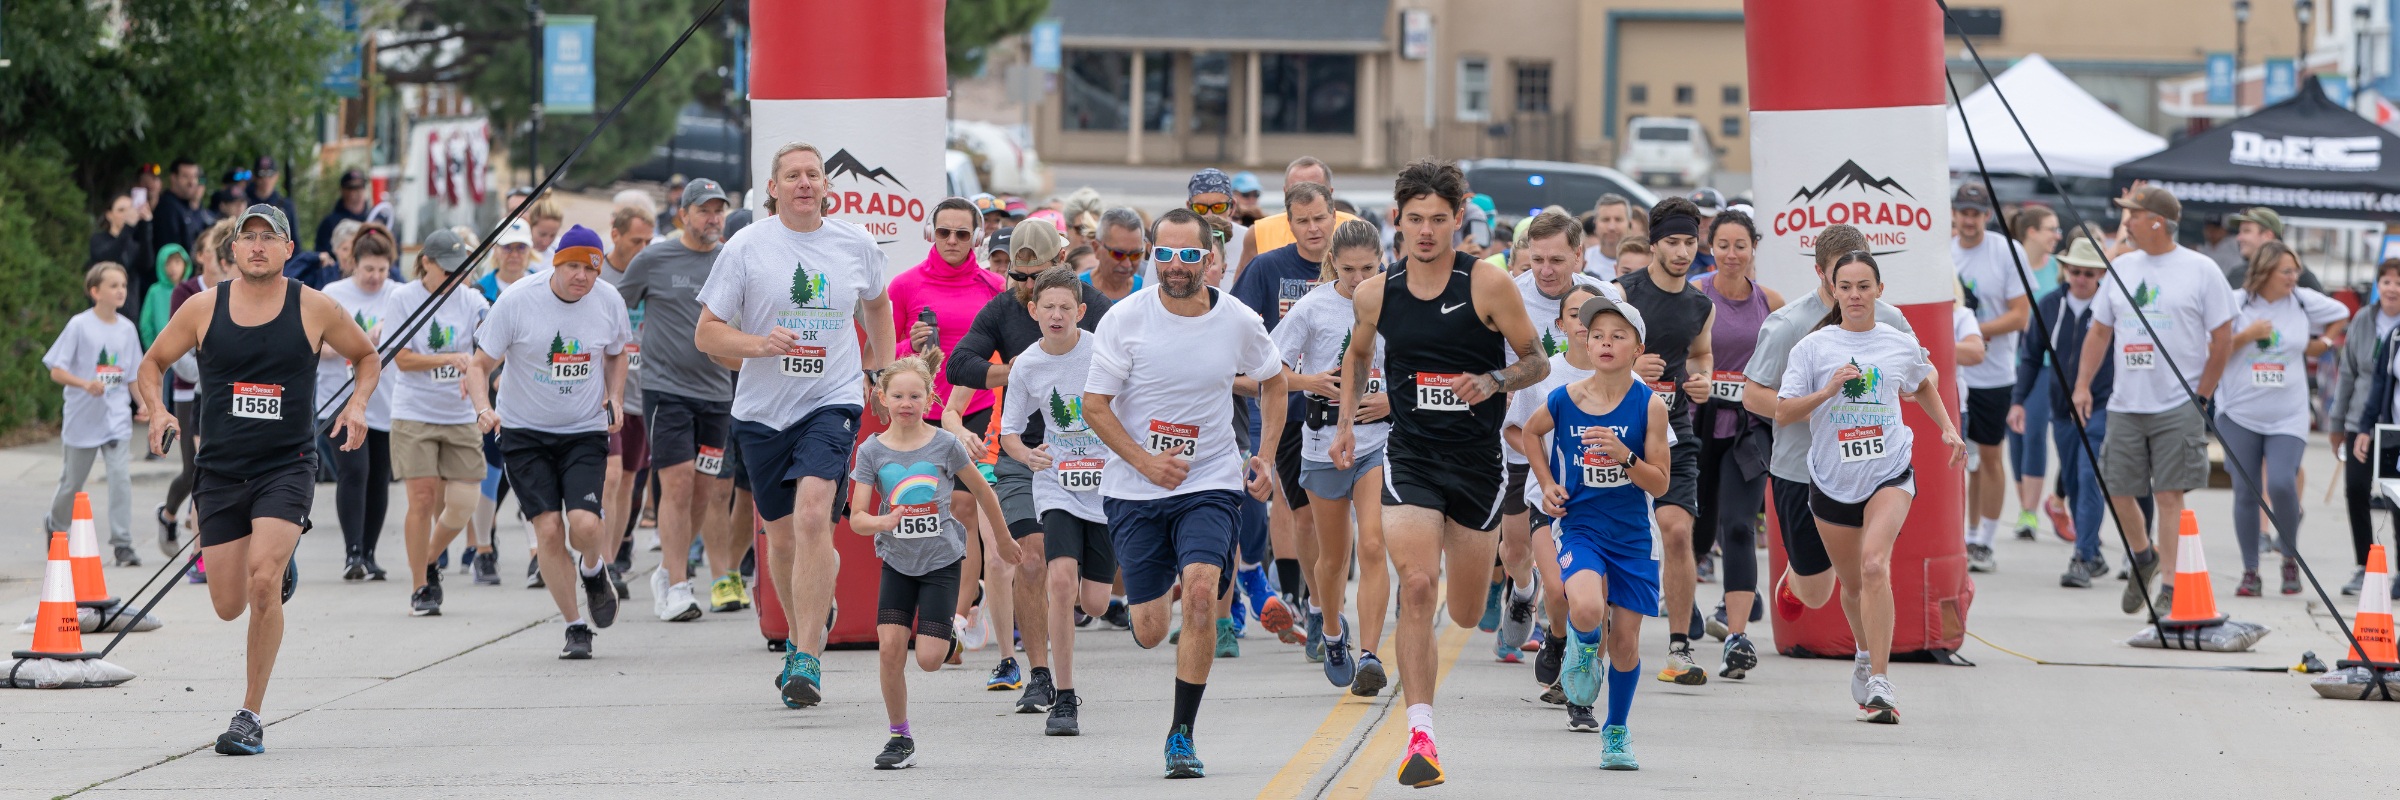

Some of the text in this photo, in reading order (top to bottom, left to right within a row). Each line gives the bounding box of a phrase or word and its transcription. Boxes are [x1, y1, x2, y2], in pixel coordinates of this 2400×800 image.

[826, 191, 925, 222] ORADO
[1774, 202, 1932, 236] COLORADO
[777, 318, 846, 330] MAIN STREET
[802, 330, 819, 341] 5K
[555, 363, 588, 377] 1636
[783, 357, 824, 374] 1559
[559, 386, 573, 395] 5K
[235, 396, 279, 415] 1558
[1829, 413, 1897, 426] MAIN STREET
[1071, 446, 1087, 456] 5K
[1842, 438, 1884, 458] 1615
[1060, 470, 1102, 487] 1566
[1585, 466, 1629, 484] 1554
[897, 516, 938, 534] 1563
